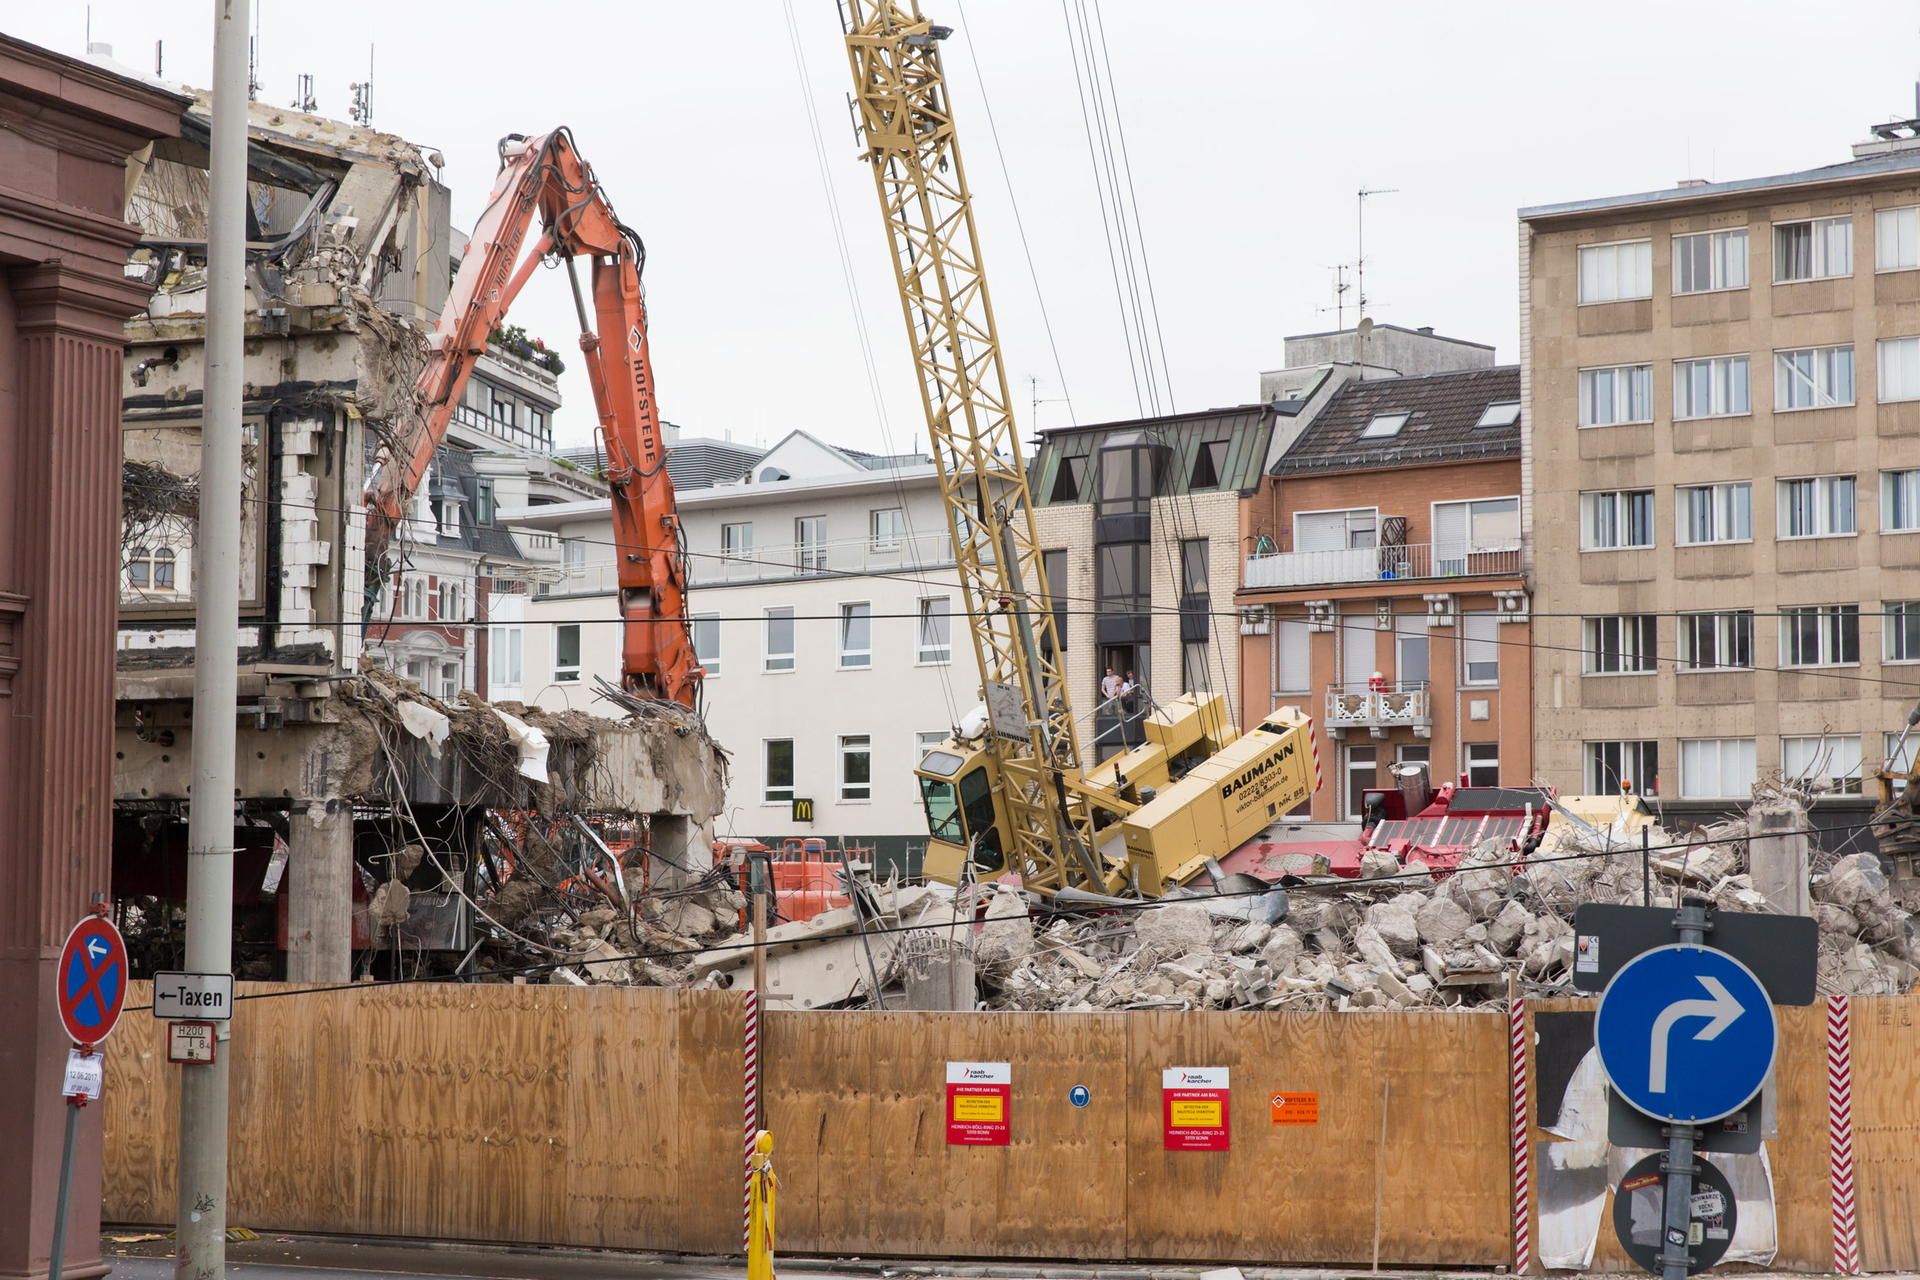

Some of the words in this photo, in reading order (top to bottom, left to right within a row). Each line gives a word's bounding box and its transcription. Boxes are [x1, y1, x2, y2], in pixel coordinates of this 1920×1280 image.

[633, 359, 656, 464] HOFSTEDE
[1222, 742, 1294, 800] BAUMANN
[1238, 782, 1258, 800] 02222
[1259, 767, 1282, 787] 8303-0
[1236, 775, 1288, 814] viktor-baumann.de
[178, 986, 222, 1007] Taxen
